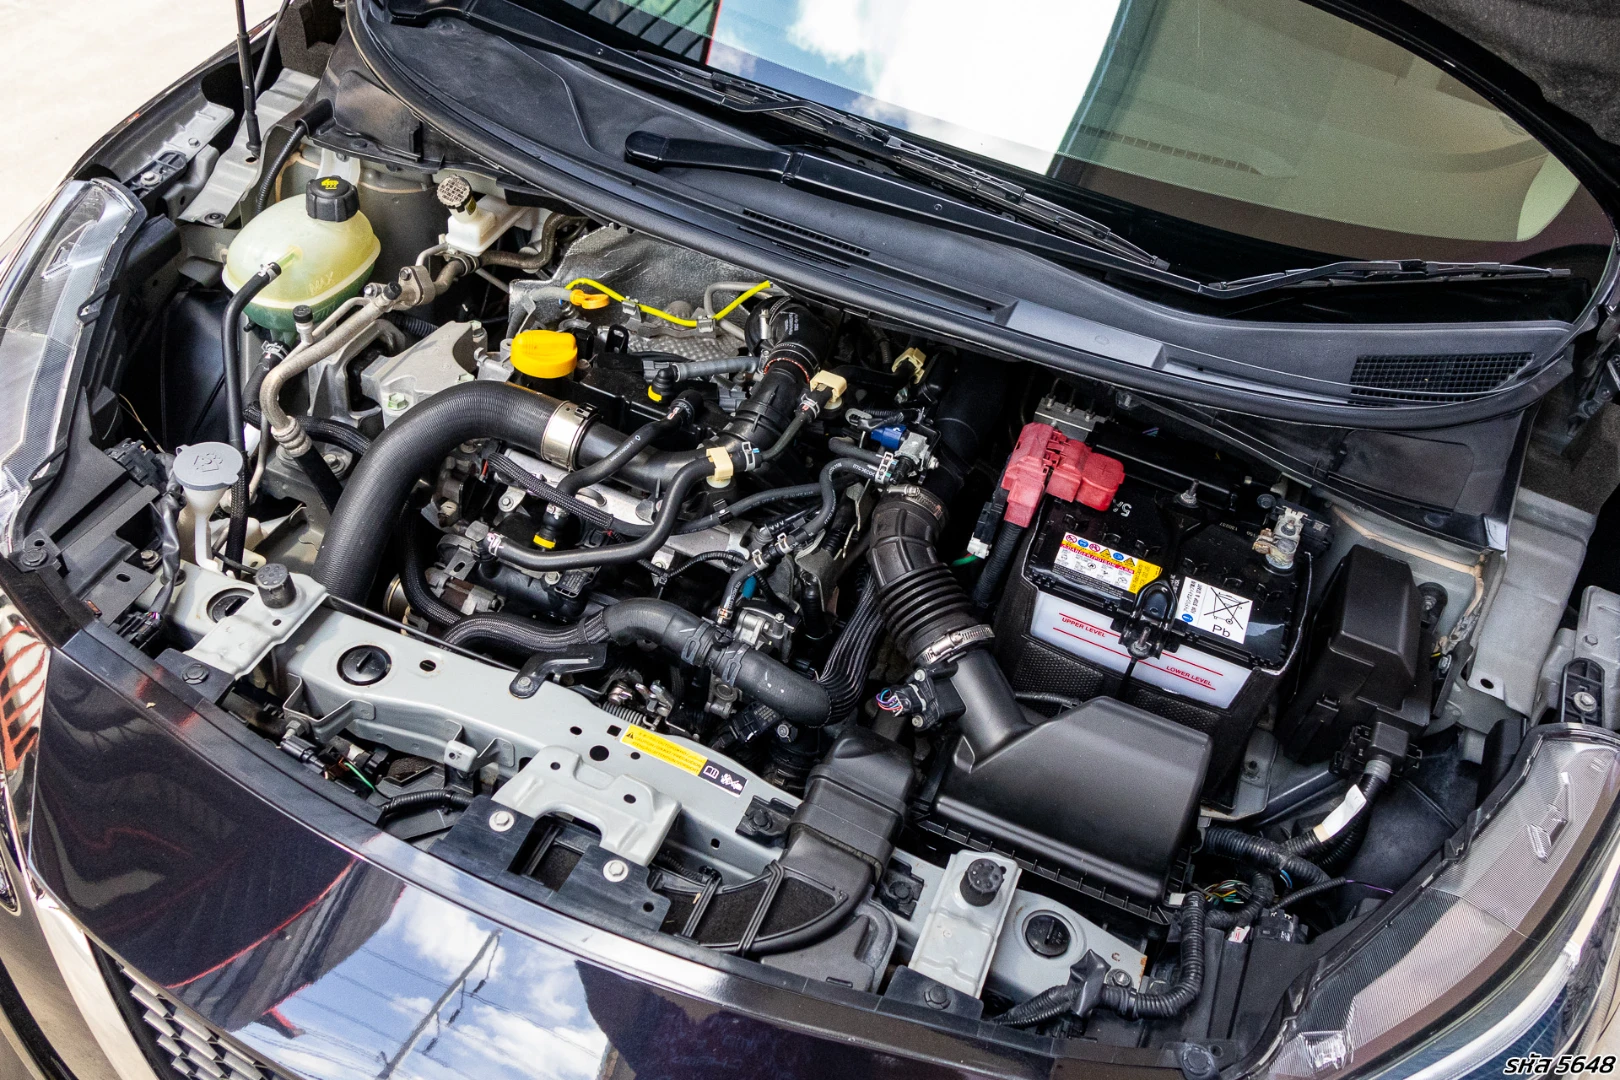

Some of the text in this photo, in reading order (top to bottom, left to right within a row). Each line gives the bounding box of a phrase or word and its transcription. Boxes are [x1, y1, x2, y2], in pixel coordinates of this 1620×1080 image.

[1061, 617, 1106, 638] UPPER LEVEL
[1212, 624, 1231, 638] Pb
[1166, 665, 1212, 687] LOWER LEVEL
